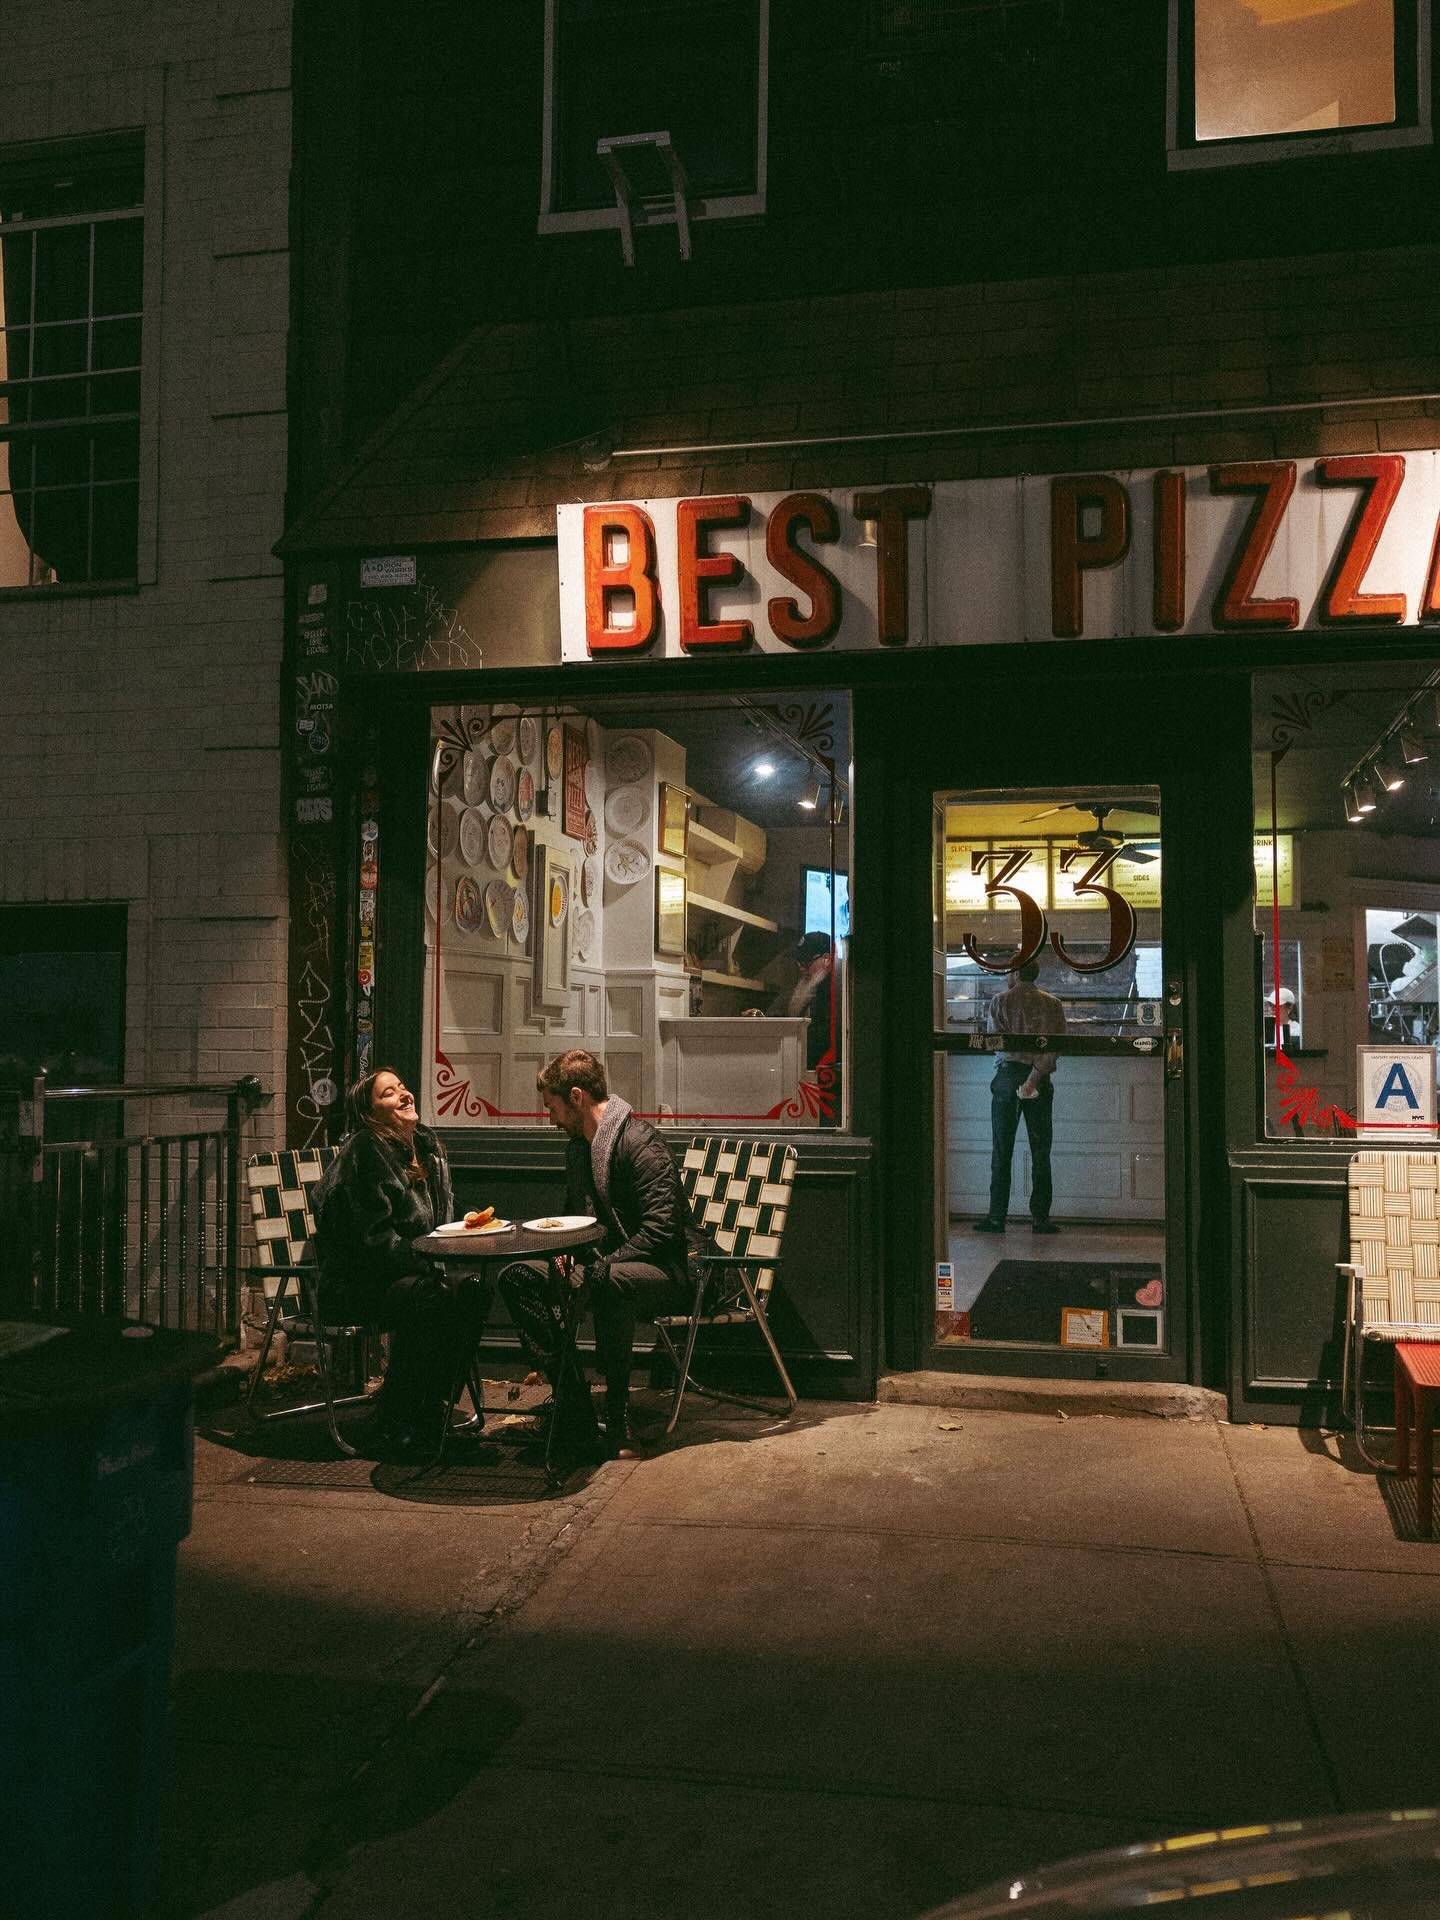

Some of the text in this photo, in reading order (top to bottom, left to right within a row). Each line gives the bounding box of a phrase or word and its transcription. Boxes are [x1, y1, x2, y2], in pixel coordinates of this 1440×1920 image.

[583, 486, 932, 657] BEST
[1050, 455, 1440, 638] PIZZ
[962, 848, 1137, 975] 33
[1375, 1063, 1419, 1109] A
